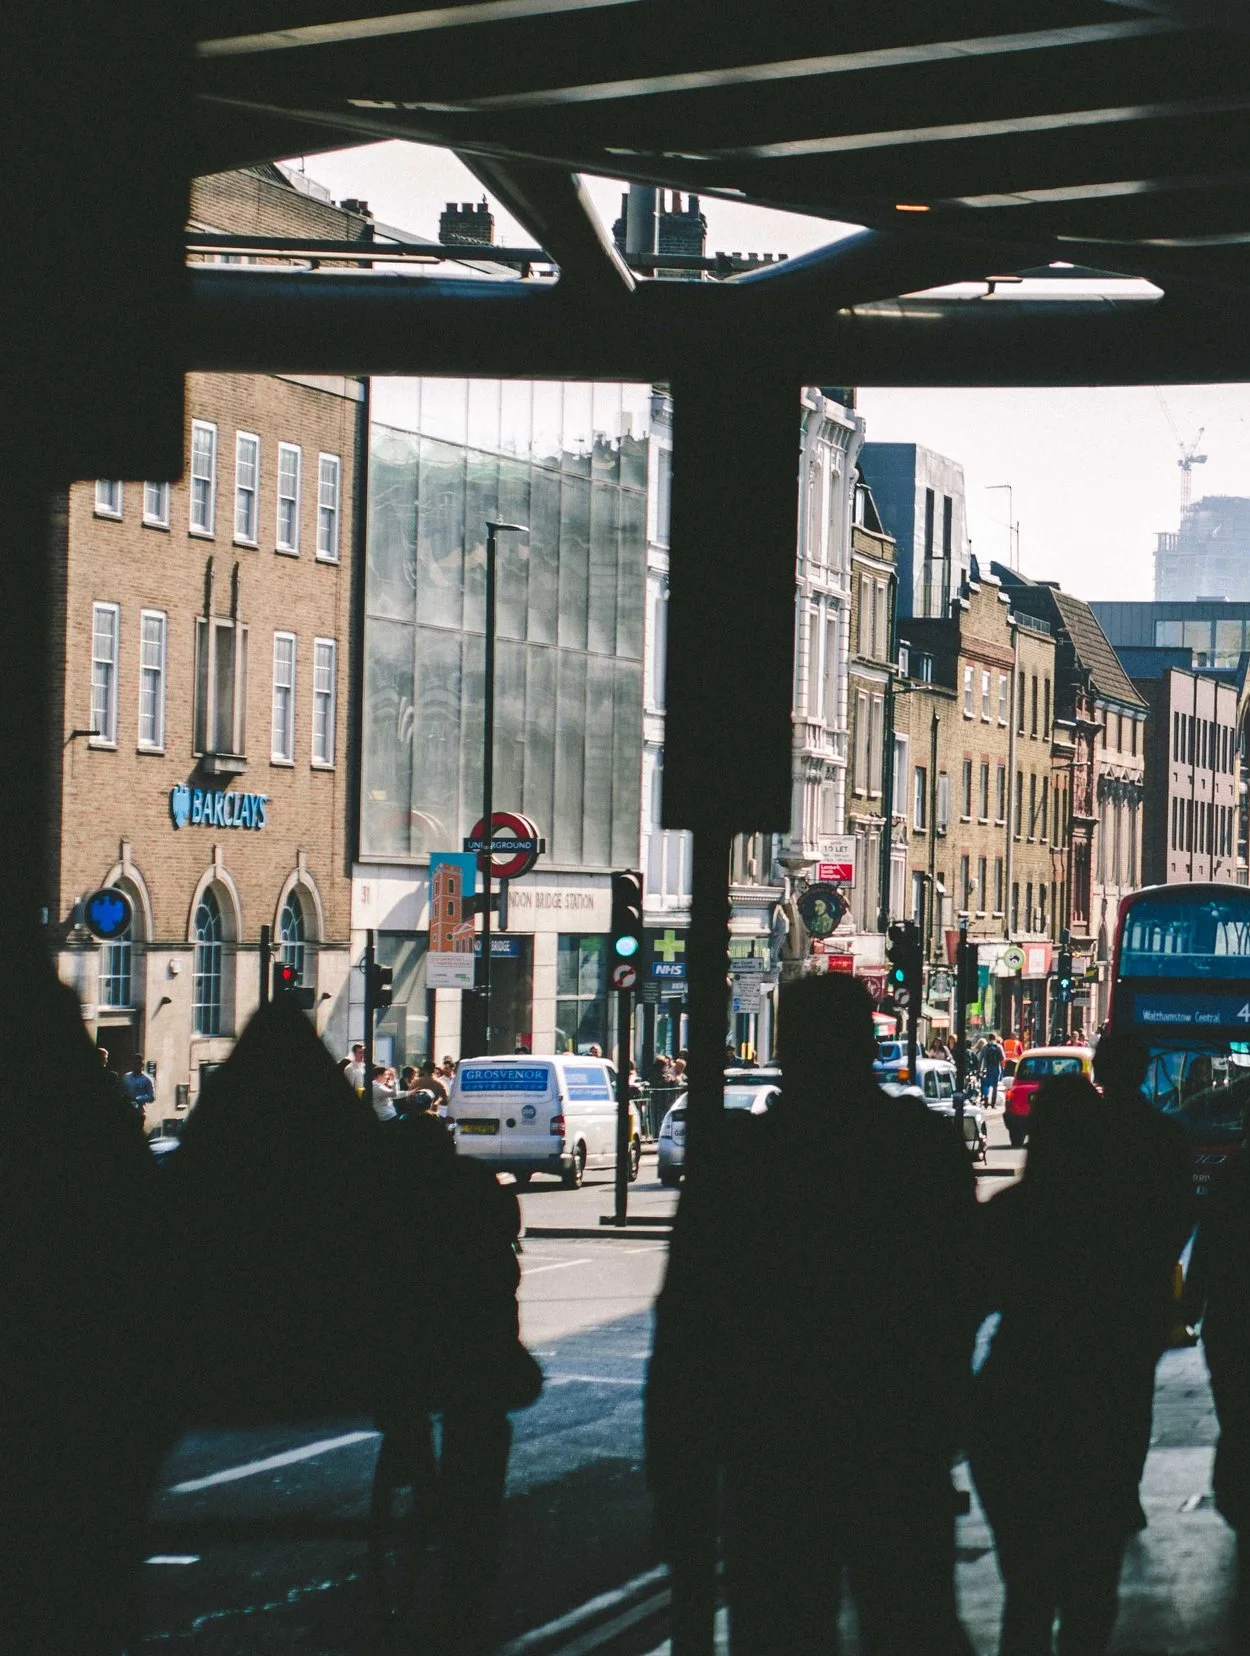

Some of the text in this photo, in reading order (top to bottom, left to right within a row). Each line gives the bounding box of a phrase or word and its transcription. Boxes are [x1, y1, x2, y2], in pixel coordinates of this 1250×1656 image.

[192, 788, 268, 828] BARCLAYS
[468, 841, 532, 849] UNRGROUND
[509, 891, 594, 910] NDON BRIDGE STATION
[655, 965, 682, 975] NHS
[1142, 1010, 1220, 1023] Walthamstow Central
[466, 1070, 543, 1080] GROSVENOR
